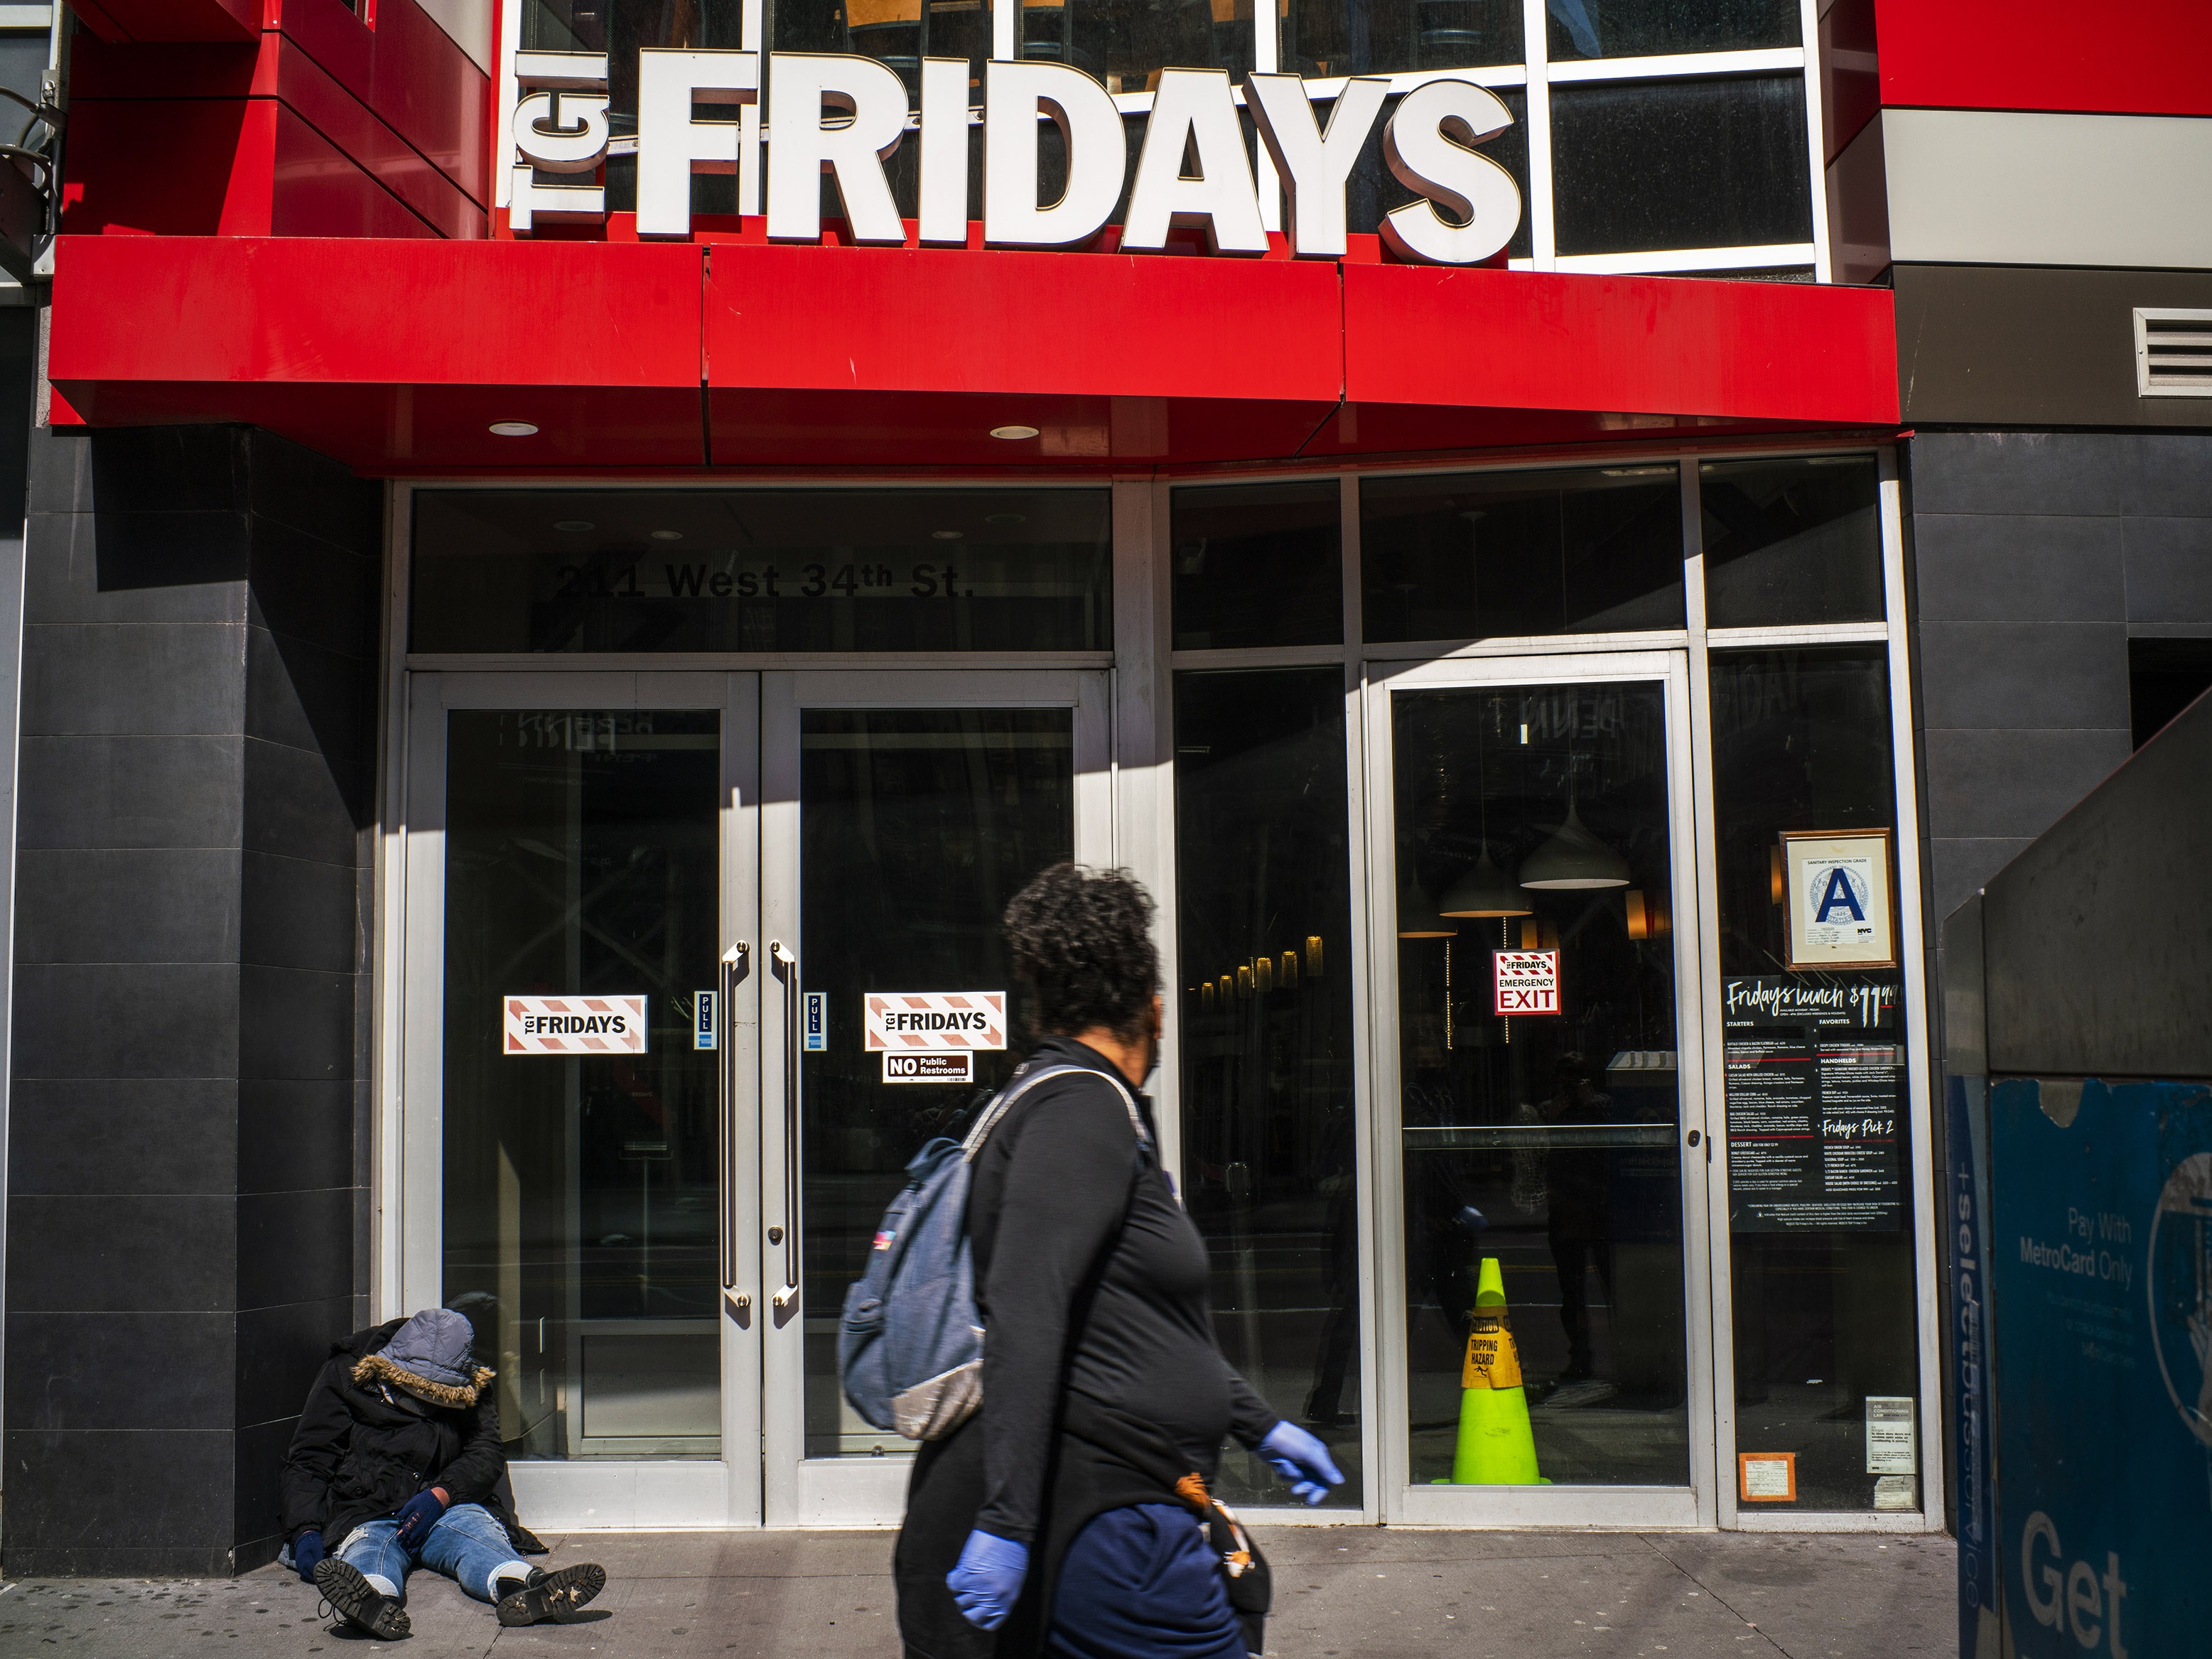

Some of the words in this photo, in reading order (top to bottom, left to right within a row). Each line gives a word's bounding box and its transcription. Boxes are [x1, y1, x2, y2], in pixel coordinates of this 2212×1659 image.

[508, 50, 609, 237] TGI
[636, 47, 1521, 265] FRIDAYS
[556, 565, 646, 598] 211
[665, 563, 780, 598] West
[801, 563, 894, 598] 34th
[911, 564, 974, 598] St.
[1815, 868, 1865, 922] A
[1500, 978, 1554, 987] EMERGENCY
[1500, 990, 1554, 1008] EXIT
[1727, 980, 1796, 1017] Fridays
[1796, 981, 1843, 1007] lunch
[525, 1015, 535, 1034] TGI
[536, 1015, 626, 1034] FRIDAYS
[886, 1012, 895, 1032] TGI
[897, 1012, 986, 1030] FRIDAYS
[890, 1059, 917, 1074] NO
[1822, 1119, 1860, 1139] Fridays
[1862, 1118, 1884, 1137] Pick
[1886, 1120, 1894, 1134] 2
[2068, 1206, 2095, 1245] Pay
[2098, 1211, 2132, 1244] With
[2019, 1236, 2095, 1277] MetroCard
[2099, 1250, 2134, 1292] Only
[1471, 1339, 1498, 1351] TRIPPING
[1471, 1353, 1494, 1365] HAZARD
[2022, 1511, 2128, 1659] Get
